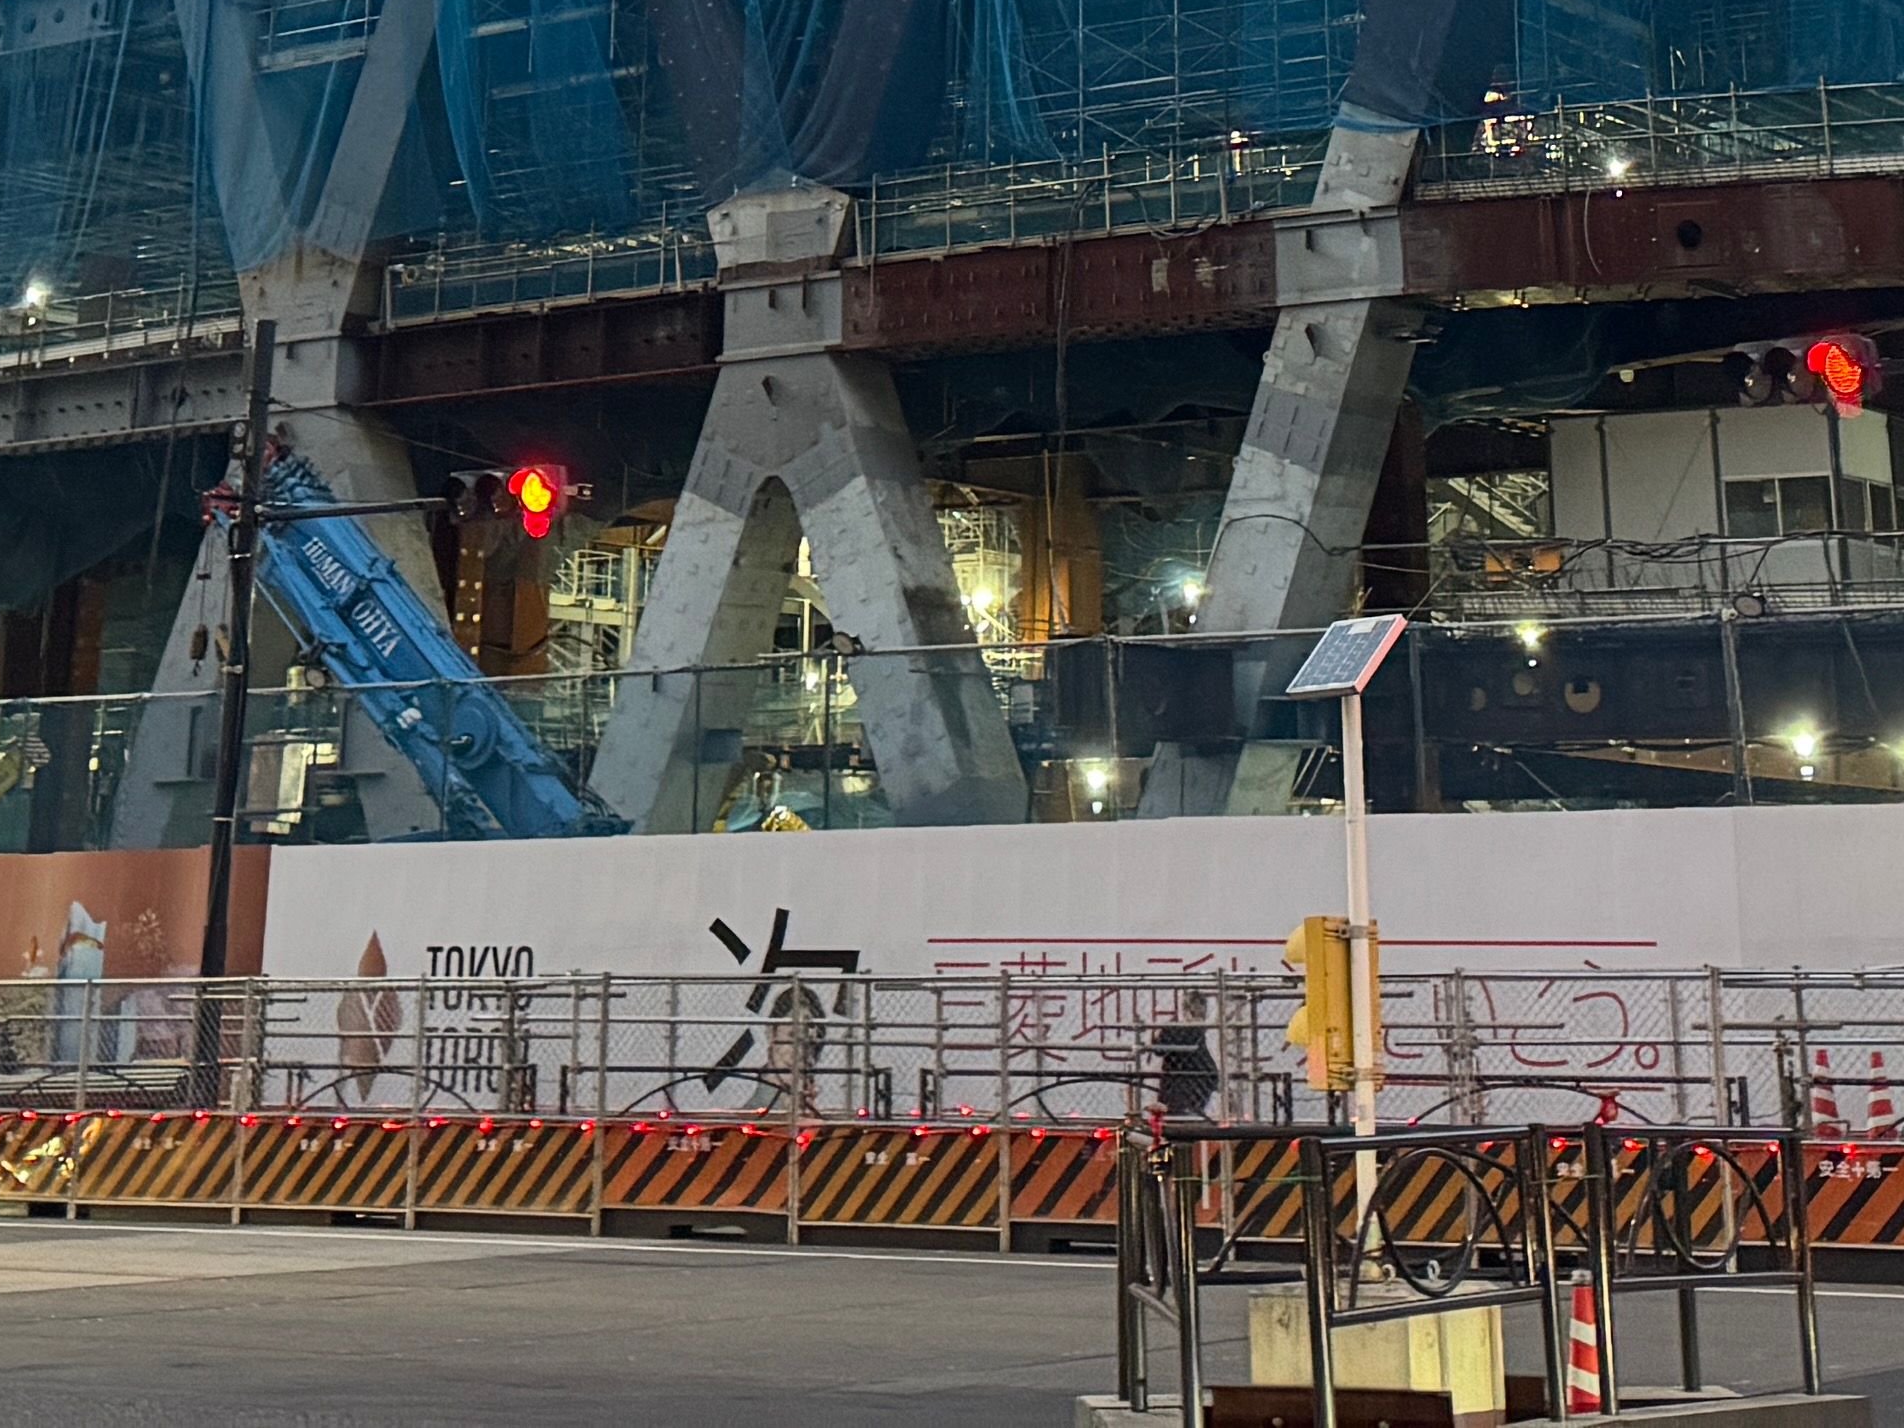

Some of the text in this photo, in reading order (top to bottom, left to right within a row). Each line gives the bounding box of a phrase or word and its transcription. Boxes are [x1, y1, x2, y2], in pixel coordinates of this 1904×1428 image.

[302, 536, 401, 658] HUMAN OHYA
[426, 945, 534, 1011] TOKYO
